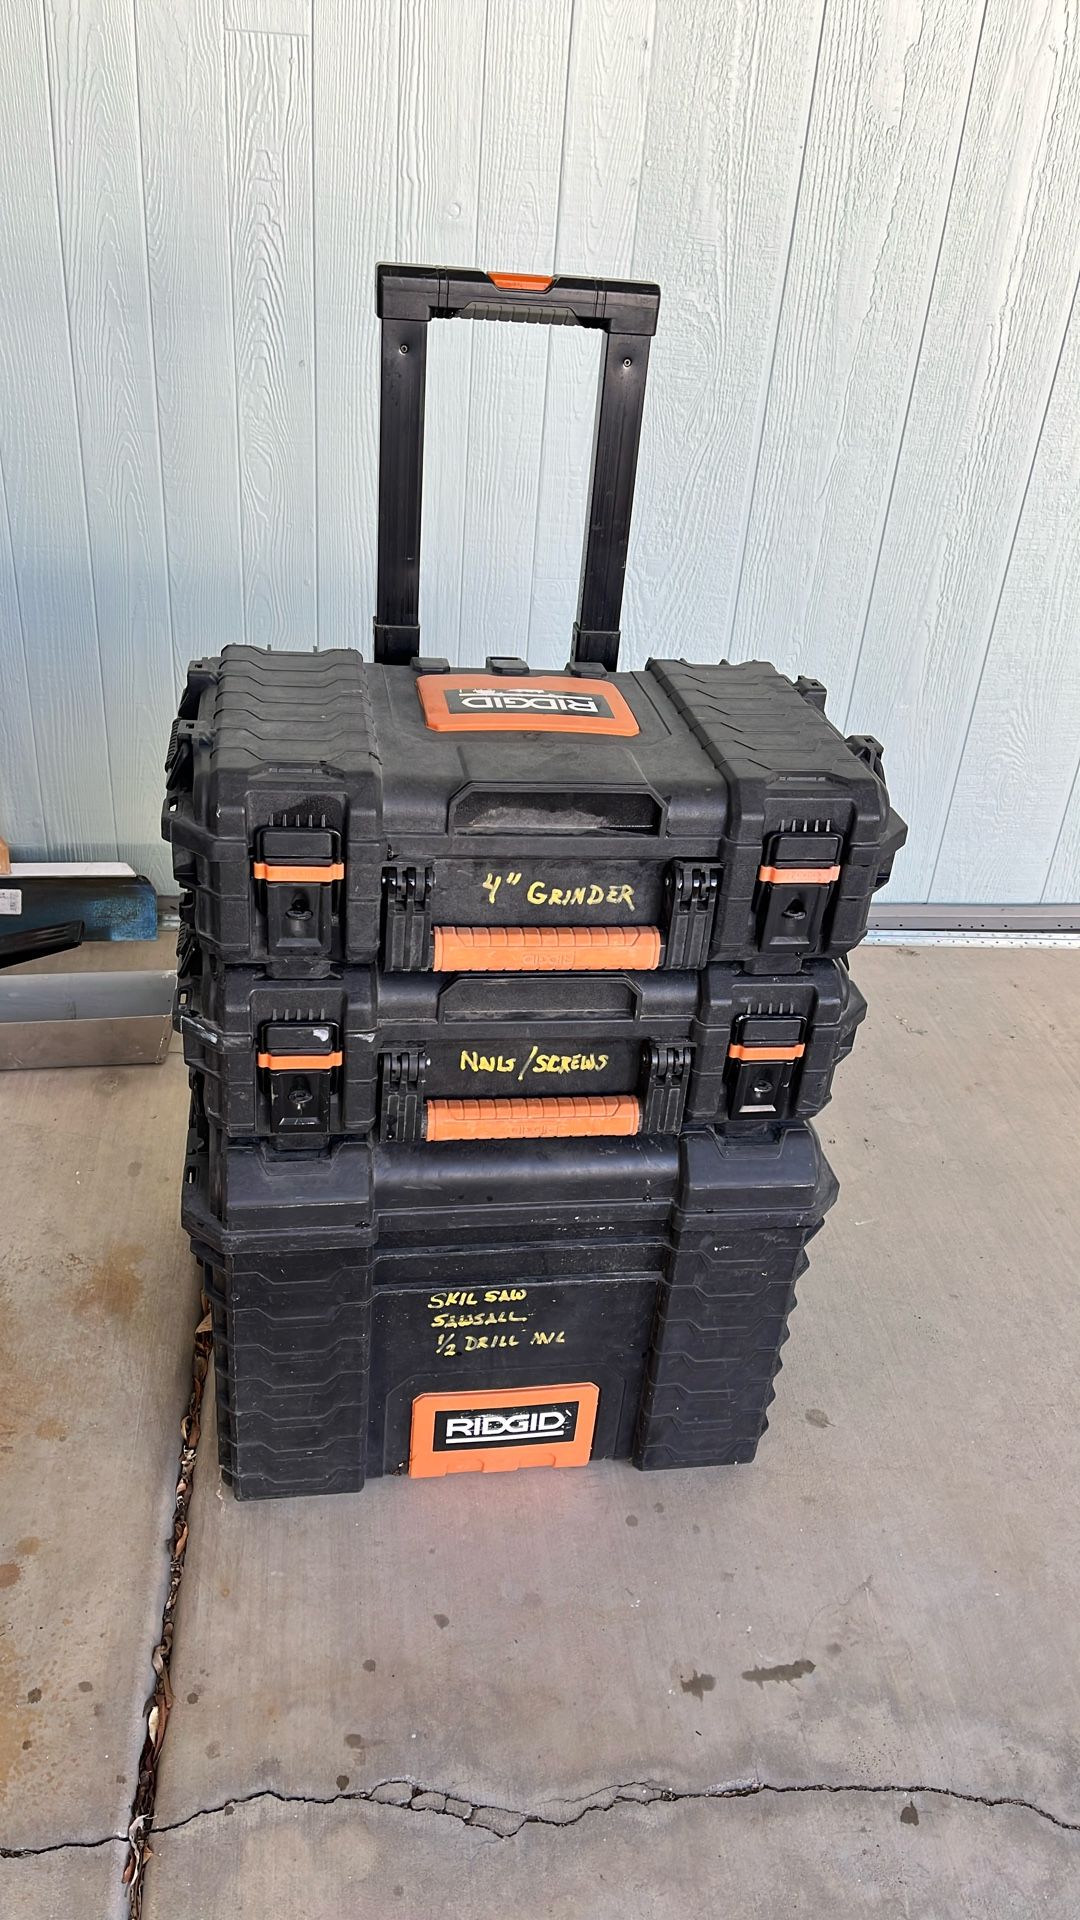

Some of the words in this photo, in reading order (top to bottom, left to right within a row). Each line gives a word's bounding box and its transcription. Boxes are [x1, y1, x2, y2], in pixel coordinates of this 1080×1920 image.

[461, 695, 599, 713] RIDGID
[482, 872, 522, 904] 4"
[527, 881, 635, 911] GRINDER
[427, 1291, 478, 1308] SKIL
[484, 1289, 528, 1303] SAW
[431, 1311, 528, 1328] SAWSALL
[435, 1333, 456, 1356] 1/2
[465, 1335, 519, 1352] DRILL
[446, 1411, 566, 1437] RIDGID
